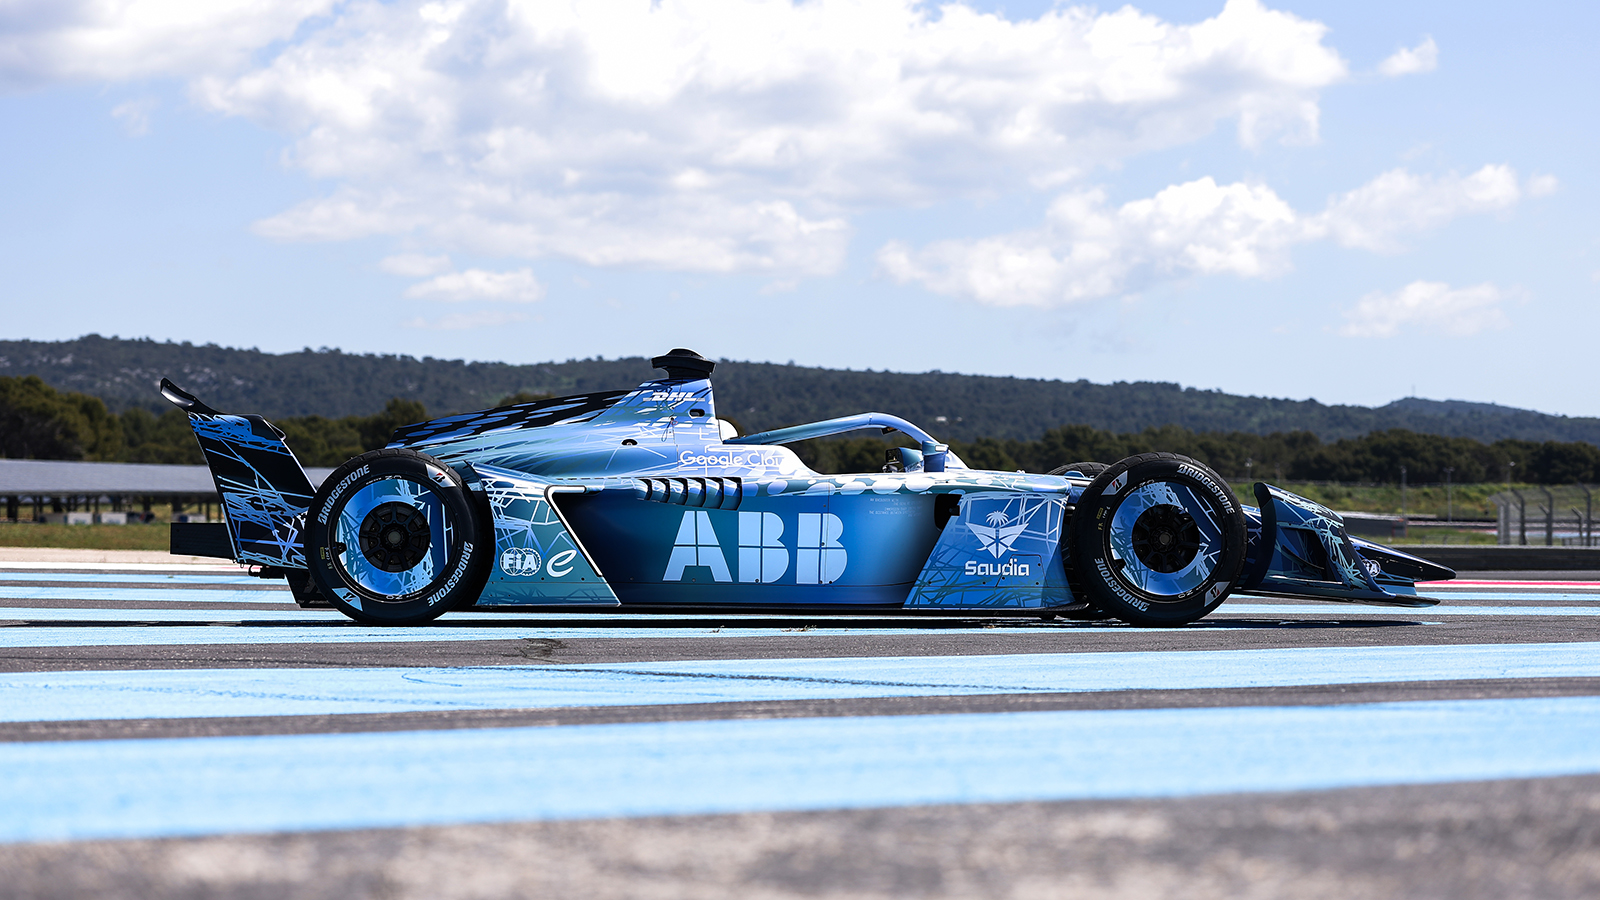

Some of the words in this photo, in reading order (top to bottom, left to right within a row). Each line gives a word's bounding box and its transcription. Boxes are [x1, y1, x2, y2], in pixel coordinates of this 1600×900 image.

[652, 392, 697, 401] DHL
[680, 450, 743, 469] Google
[317, 464, 371, 526] BRIDGESTONE
[1176, 463, 1235, 515] BRIDGESTONE
[662, 510, 848, 584] ABB
[964, 558, 1030, 576] Saudia
[427, 541, 474, 607] BRIDGESTONE
[1094, 557, 1151, 612] BRIDGESTONE
